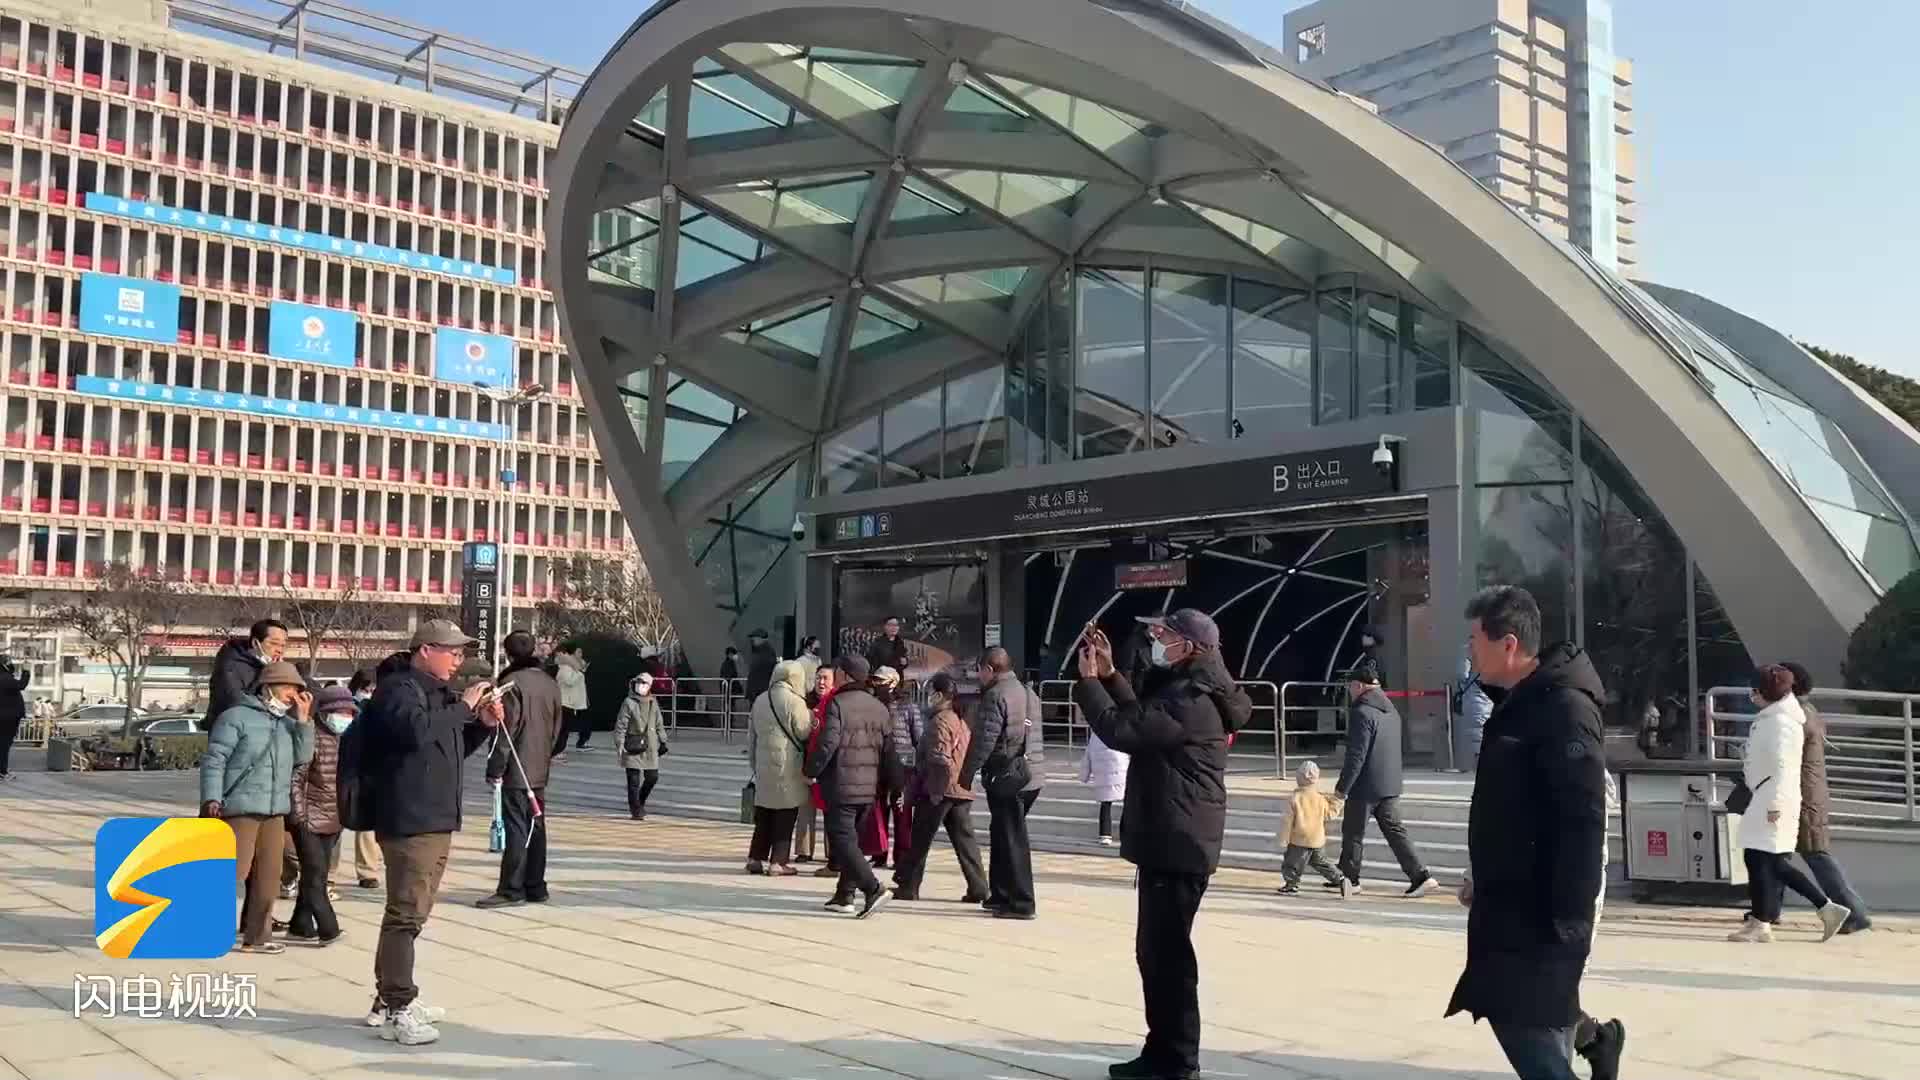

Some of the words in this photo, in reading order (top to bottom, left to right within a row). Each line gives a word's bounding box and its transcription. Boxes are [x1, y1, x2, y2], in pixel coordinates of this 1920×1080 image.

[1273, 465, 1289, 492] B
[1297, 461, 1340, 479] 出入口
[1027, 488, 1088, 509] 泉城公园站
[480, 584, 489, 597] B
